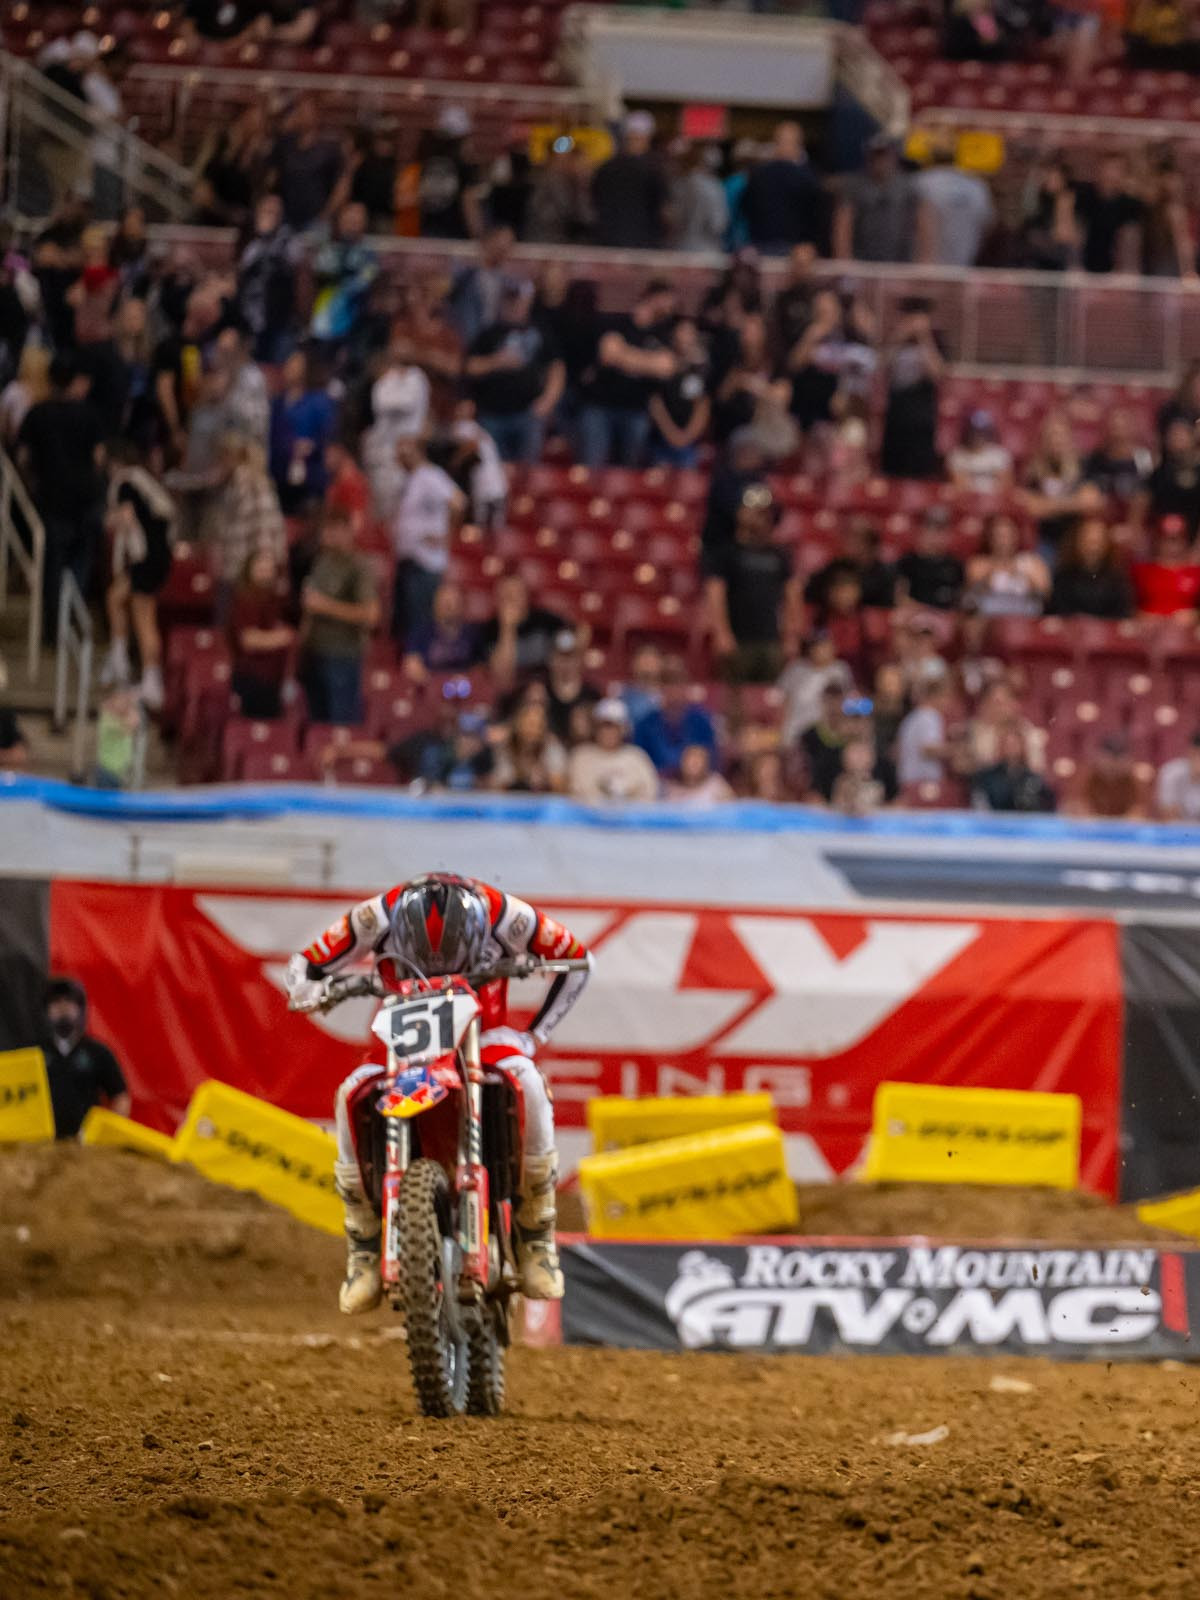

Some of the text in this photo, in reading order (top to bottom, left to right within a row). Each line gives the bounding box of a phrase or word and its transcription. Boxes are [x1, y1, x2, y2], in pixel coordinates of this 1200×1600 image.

[391, 1000, 454, 1058] 51
[740, 1244, 1156, 1289] ROCKY MOUNTAIN
